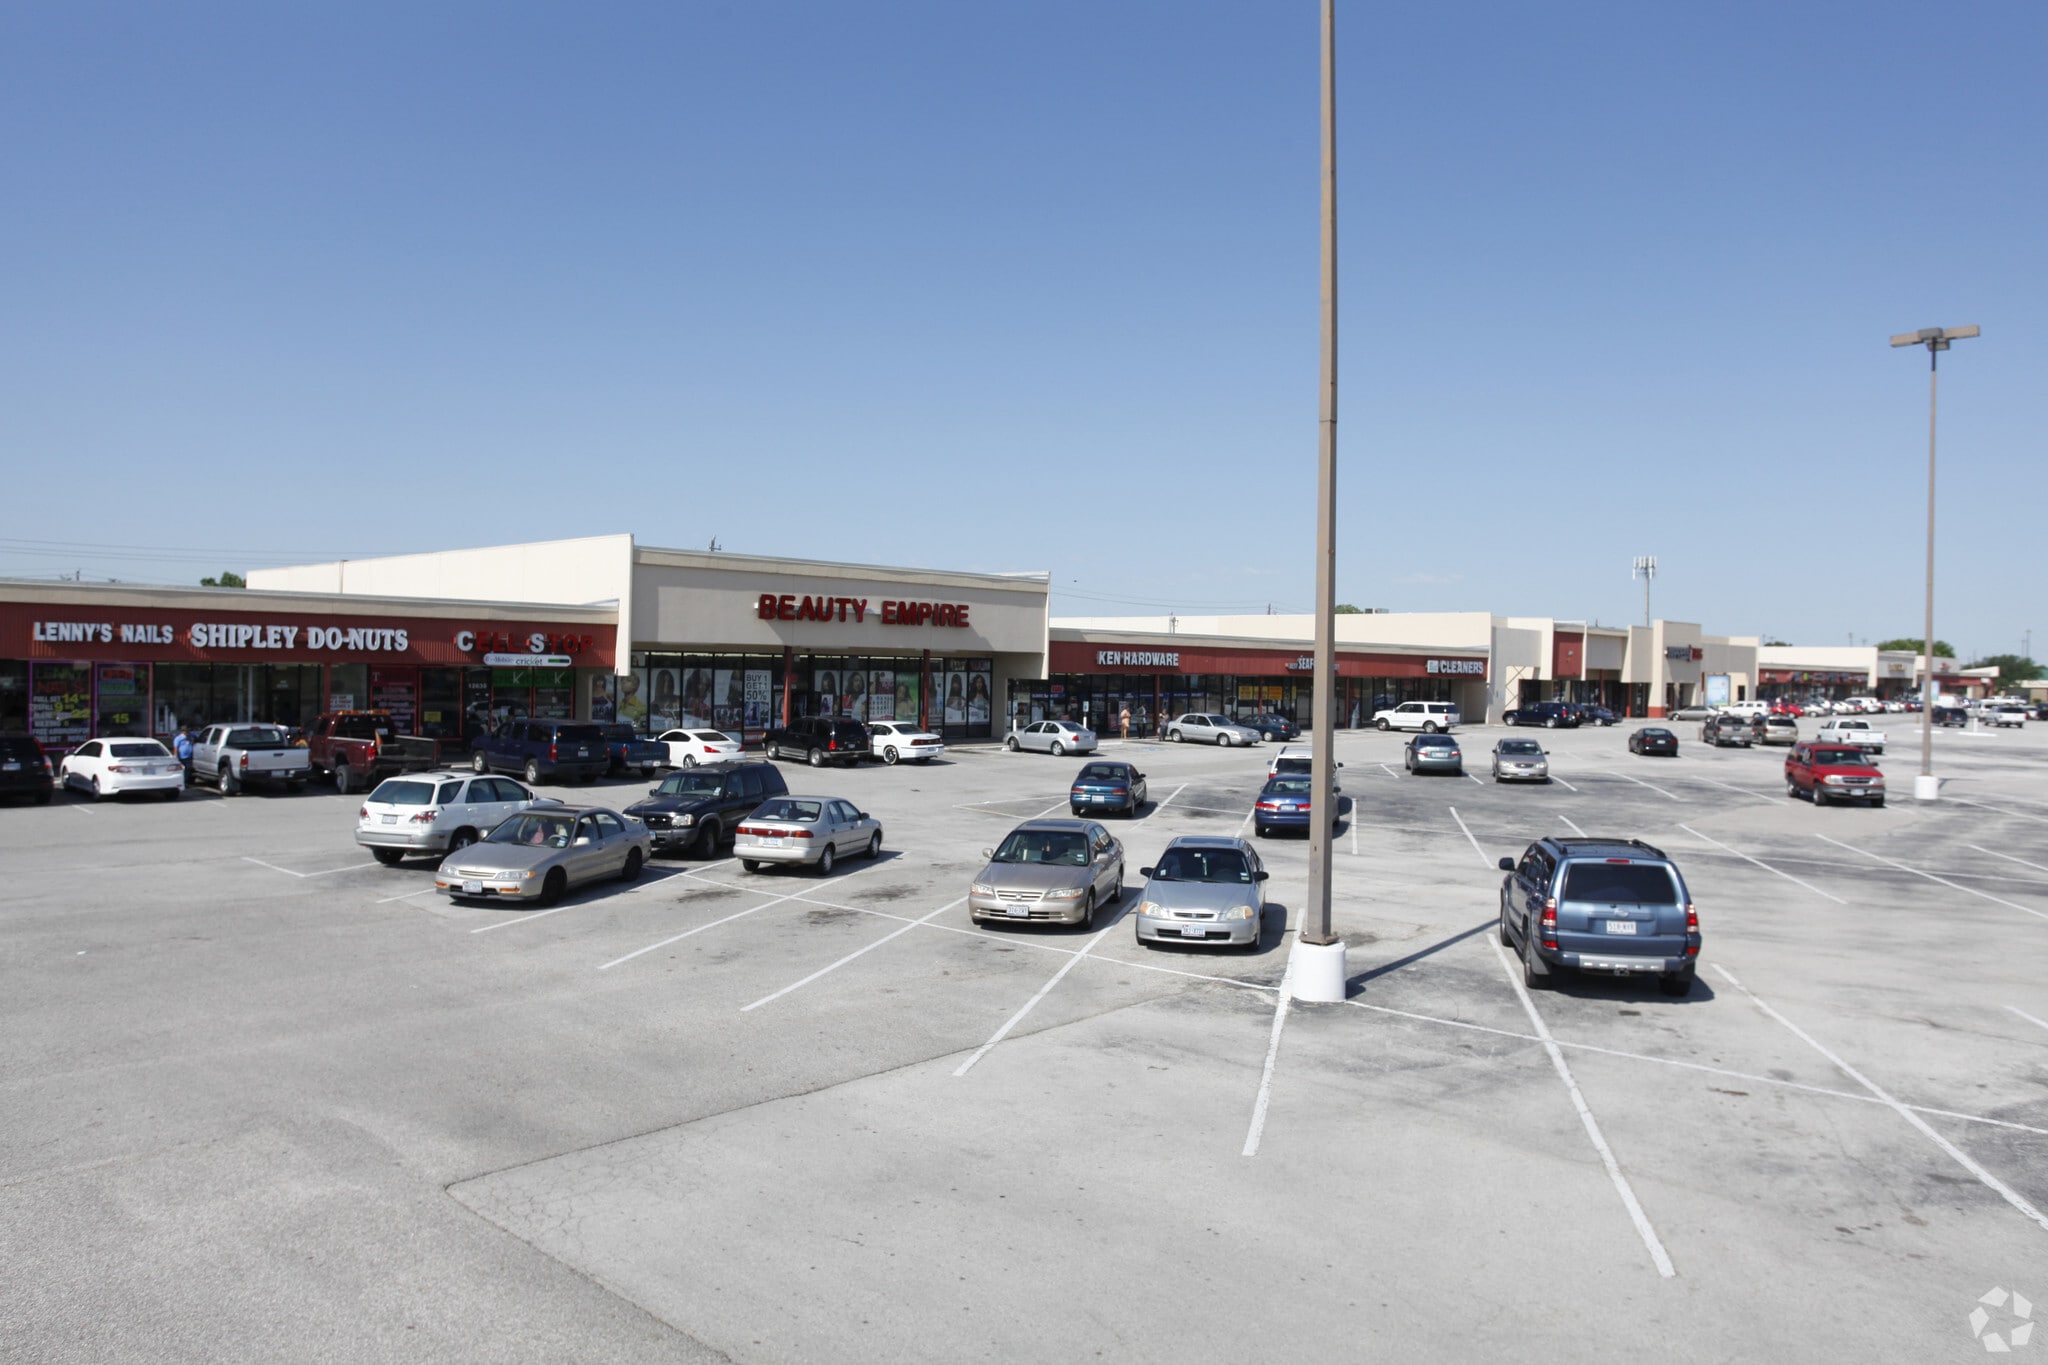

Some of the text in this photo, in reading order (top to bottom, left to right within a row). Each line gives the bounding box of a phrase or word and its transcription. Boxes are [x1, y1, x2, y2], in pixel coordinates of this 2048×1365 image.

[758, 594, 970, 628] BEAUTY EMPIRE
[33, 621, 173, 644] LENNY'S NAILS
[190, 623, 409, 651] SHIPLEY DO-NUTS
[457, 630, 594, 653] CELL STOP
[515, 655, 544, 666] cricket
[1097, 651, 1179, 667] KEN HARDWARE
[1440, 660, 1484, 674] CLEANERS
[746, 674, 762, 682] BUY
[746, 682, 762, 690] GET
[746, 690, 768, 701] 50%
[113, 713, 129, 724] 15
